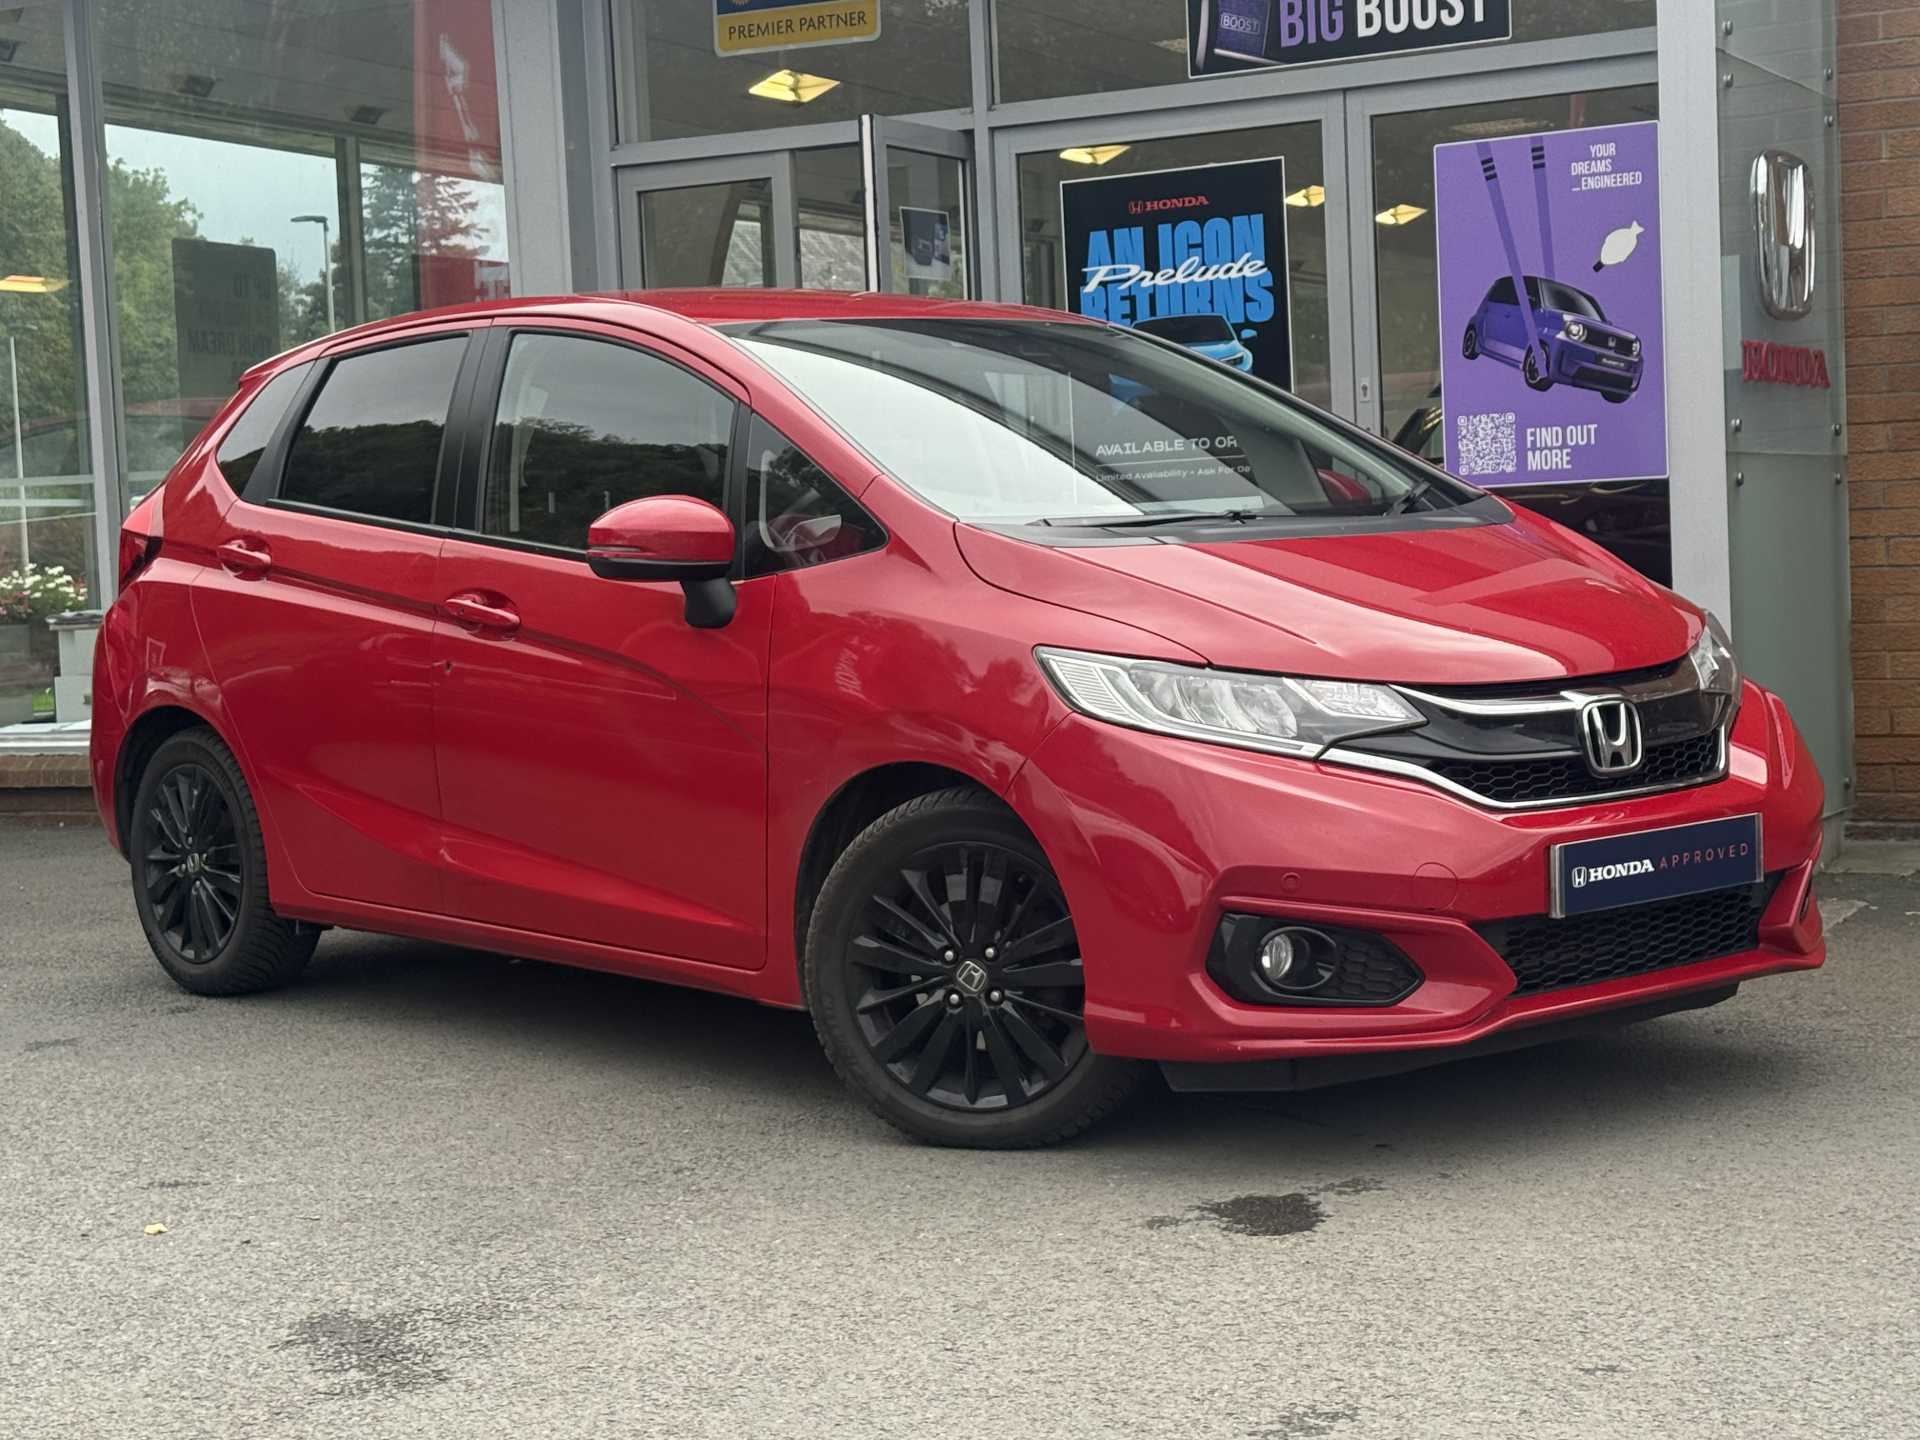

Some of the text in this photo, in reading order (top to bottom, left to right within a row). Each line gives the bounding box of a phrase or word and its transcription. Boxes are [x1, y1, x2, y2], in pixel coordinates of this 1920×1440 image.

[728, 11, 867, 40] PREMIER PARTNER
[1222, 15, 1258, 31] BOOST
[1279, 0, 1344, 48] BIG
[1590, 142, 1616, 158] YOUR
[1571, 158, 1612, 176] DREAMS
[1145, 195, 1210, 211] HONDA
[1086, 213, 1266, 282] AN ICON
[1081, 252, 1269, 293] Prelude
[1095, 439, 1185, 457] AVAILABLE
[1189, 437, 1210, 450] TO
[1526, 424, 1598, 448] FIND OUT
[1527, 448, 1572, 471] MORE
[1588, 842, 1749, 882] HONDA APPROVED
